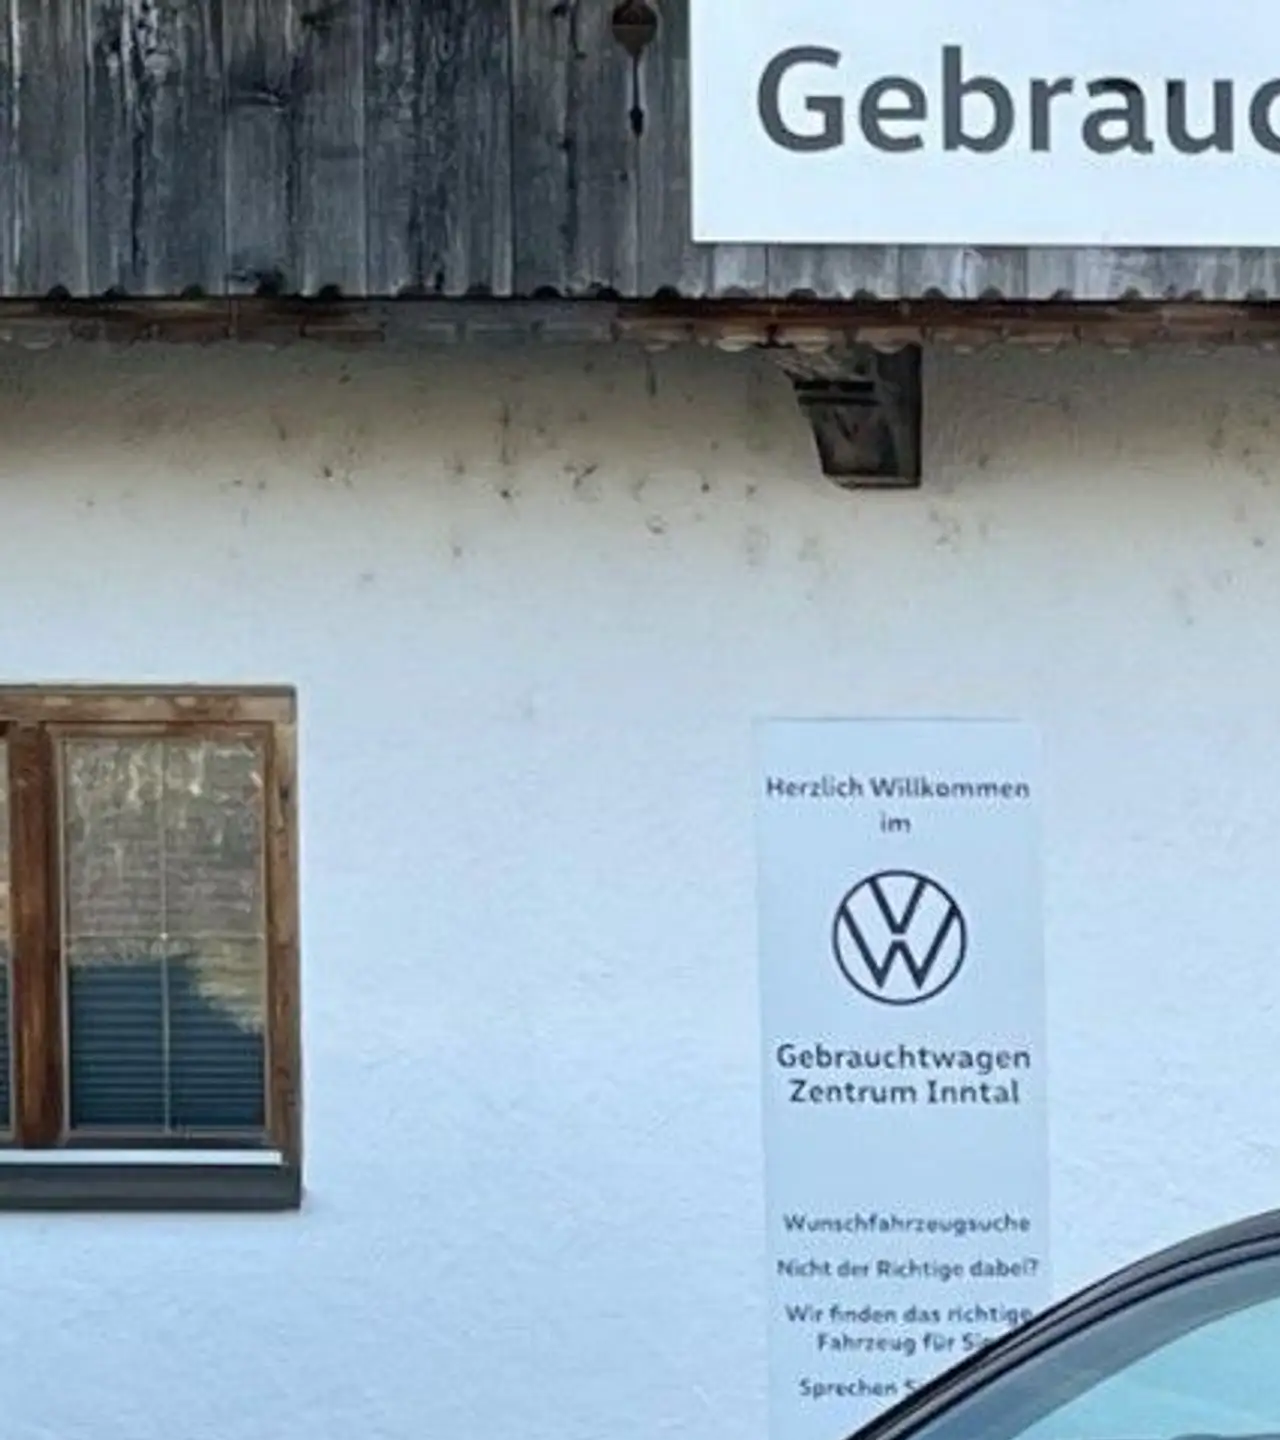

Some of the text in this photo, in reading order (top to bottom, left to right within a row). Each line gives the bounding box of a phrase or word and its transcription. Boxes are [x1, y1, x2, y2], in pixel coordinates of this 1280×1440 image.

[766, 776, 1031, 799] Herzlich Willkommen
[880, 815, 911, 834] im
[836, 873, 962, 999] VW
[776, 1043, 1032, 1075] Gebrauchtwagen
[788, 1078, 1020, 1105] Zentrum Inntal
[783, 1213, 1031, 1237] Wunschfahrzeugsuche
[777, 1258, 1039, 1282] Nicht der Richtige dabei?
[785, 1304, 824, 1323] Wir
[829, 1304, 897, 1324] finden
[903, 1304, 940, 1324] das
[816, 1333, 917, 1357] Fahrzeug
[923, 1333, 955, 1352] für
[798, 1378, 898, 1400] Sprechen
